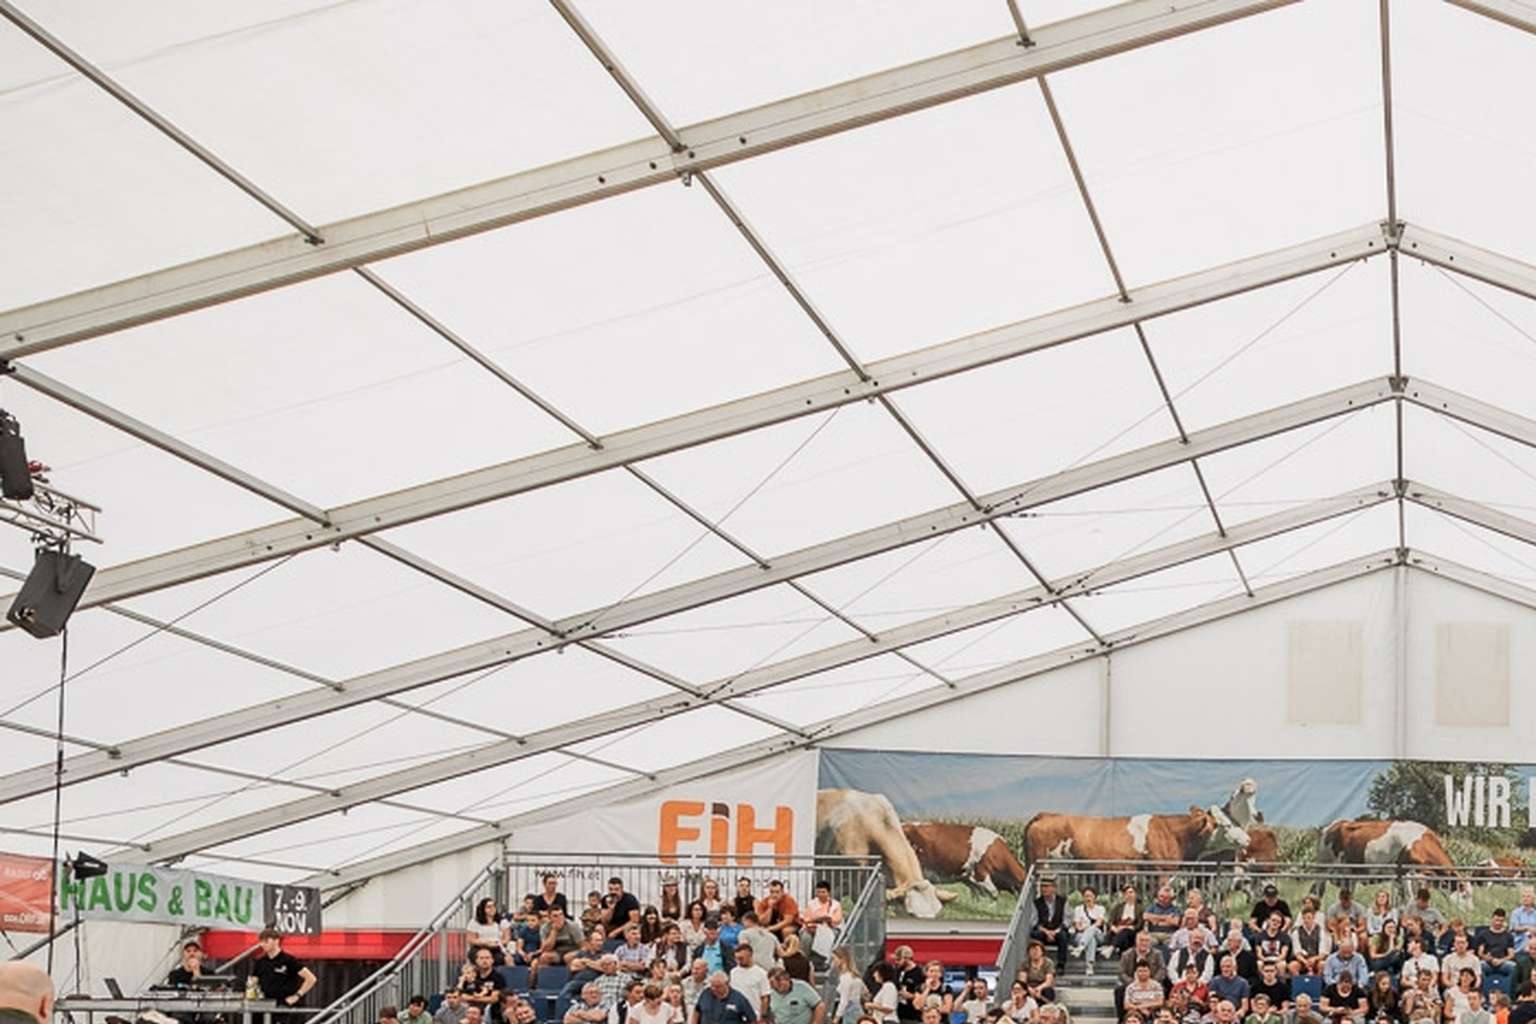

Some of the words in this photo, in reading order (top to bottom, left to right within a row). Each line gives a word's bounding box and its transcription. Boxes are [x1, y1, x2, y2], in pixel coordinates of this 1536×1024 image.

[1444, 774, 1512, 828] WIR
[61, 870, 158, 912] HAUS
[168, 885, 185, 916] &
[194, 879, 254, 925] BAU
[274, 911, 312, 934] NOV.
